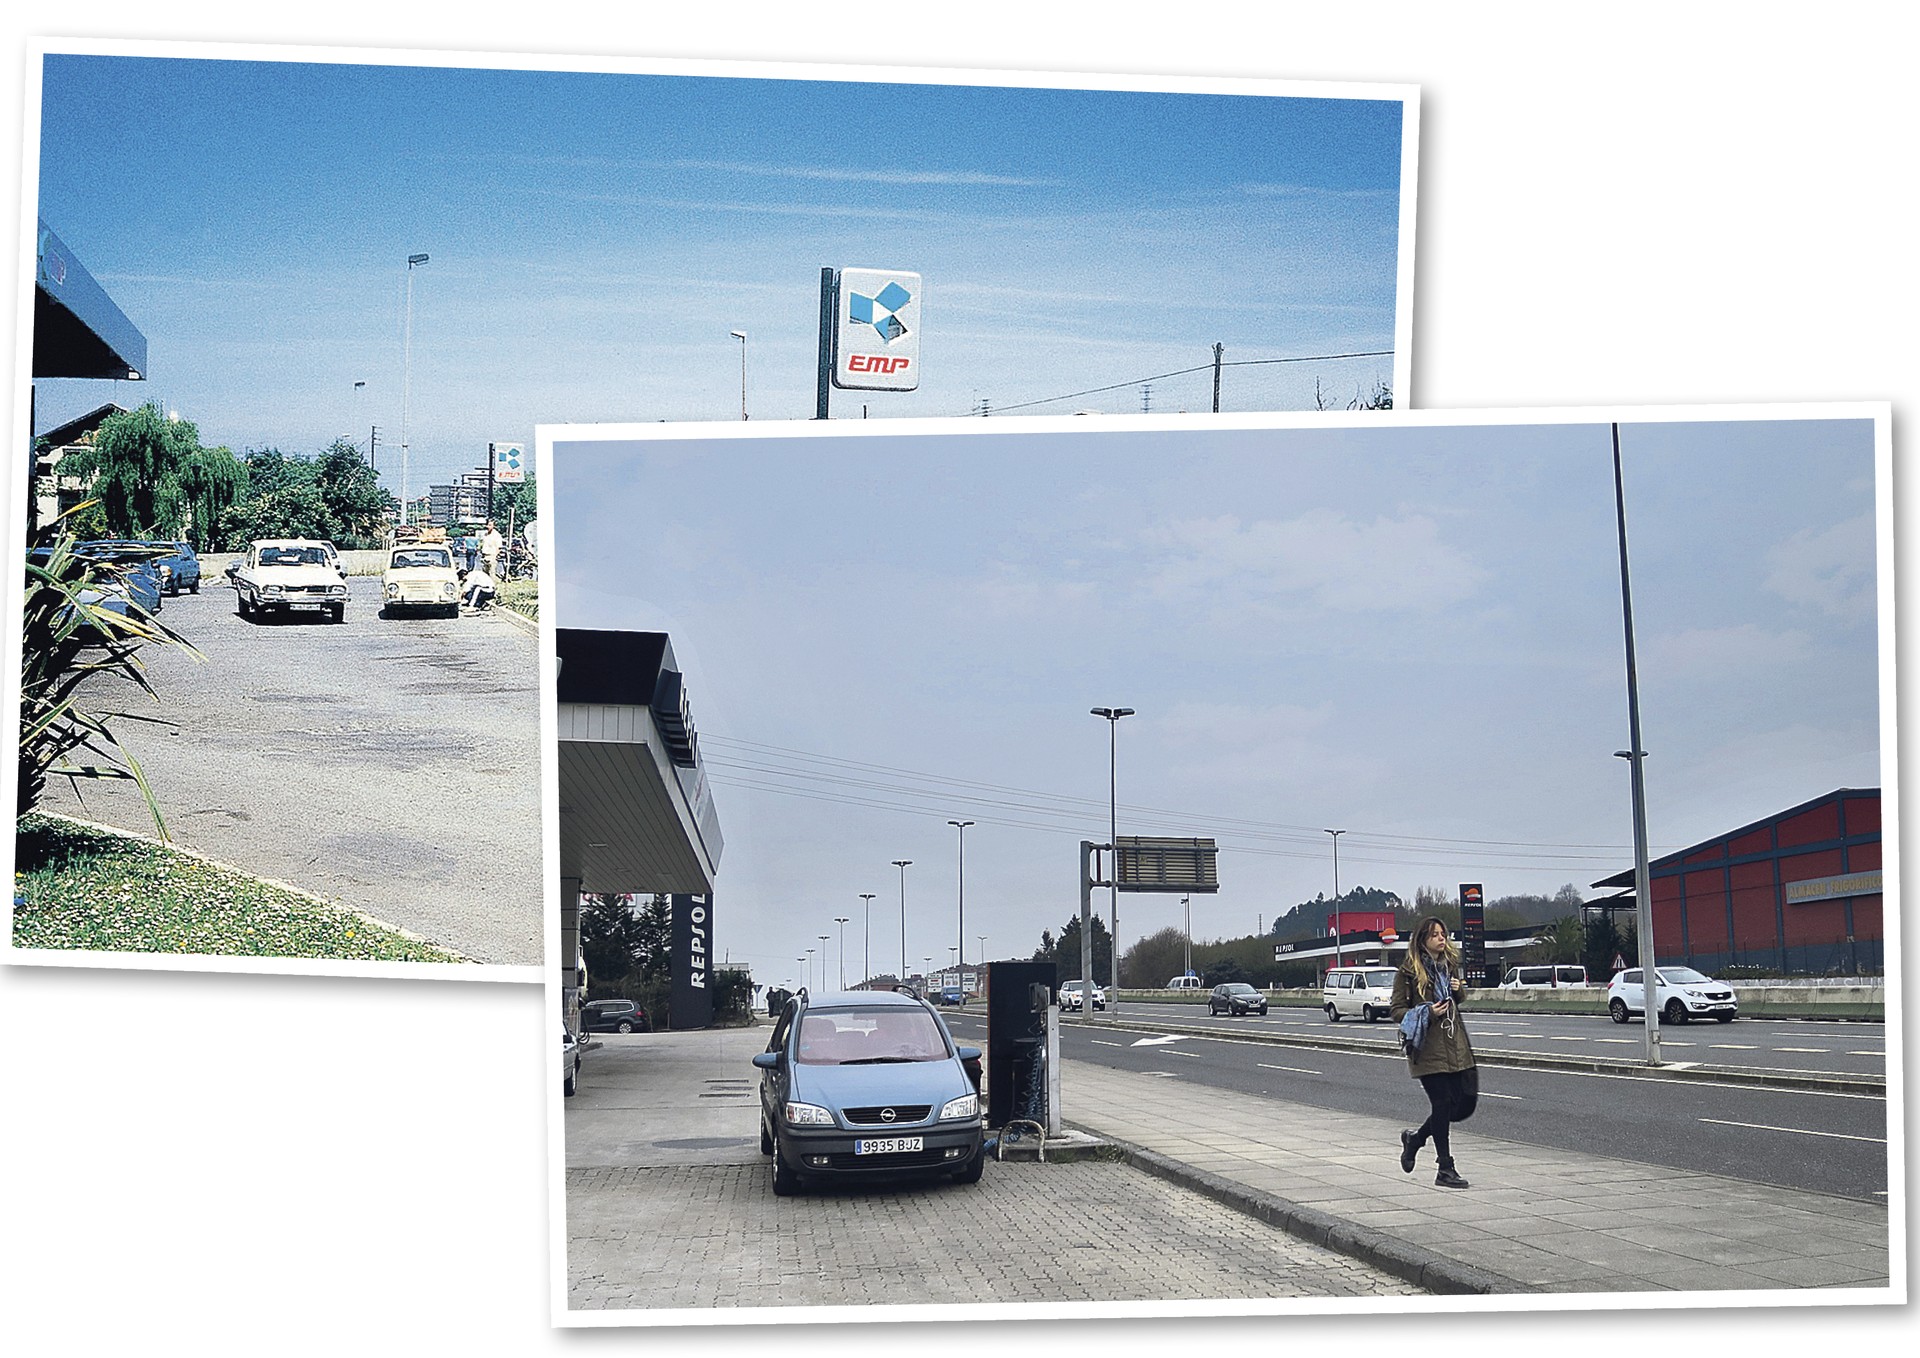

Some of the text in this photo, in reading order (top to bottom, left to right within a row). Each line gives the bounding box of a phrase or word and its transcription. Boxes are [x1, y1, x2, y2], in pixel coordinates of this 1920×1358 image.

[848, 355, 909, 374] EMP
[690, 893, 706, 989] REPSOL
[1275, 943, 1294, 953] REPSOL
[863, 1138, 920, 1153] 9935 BJZ
